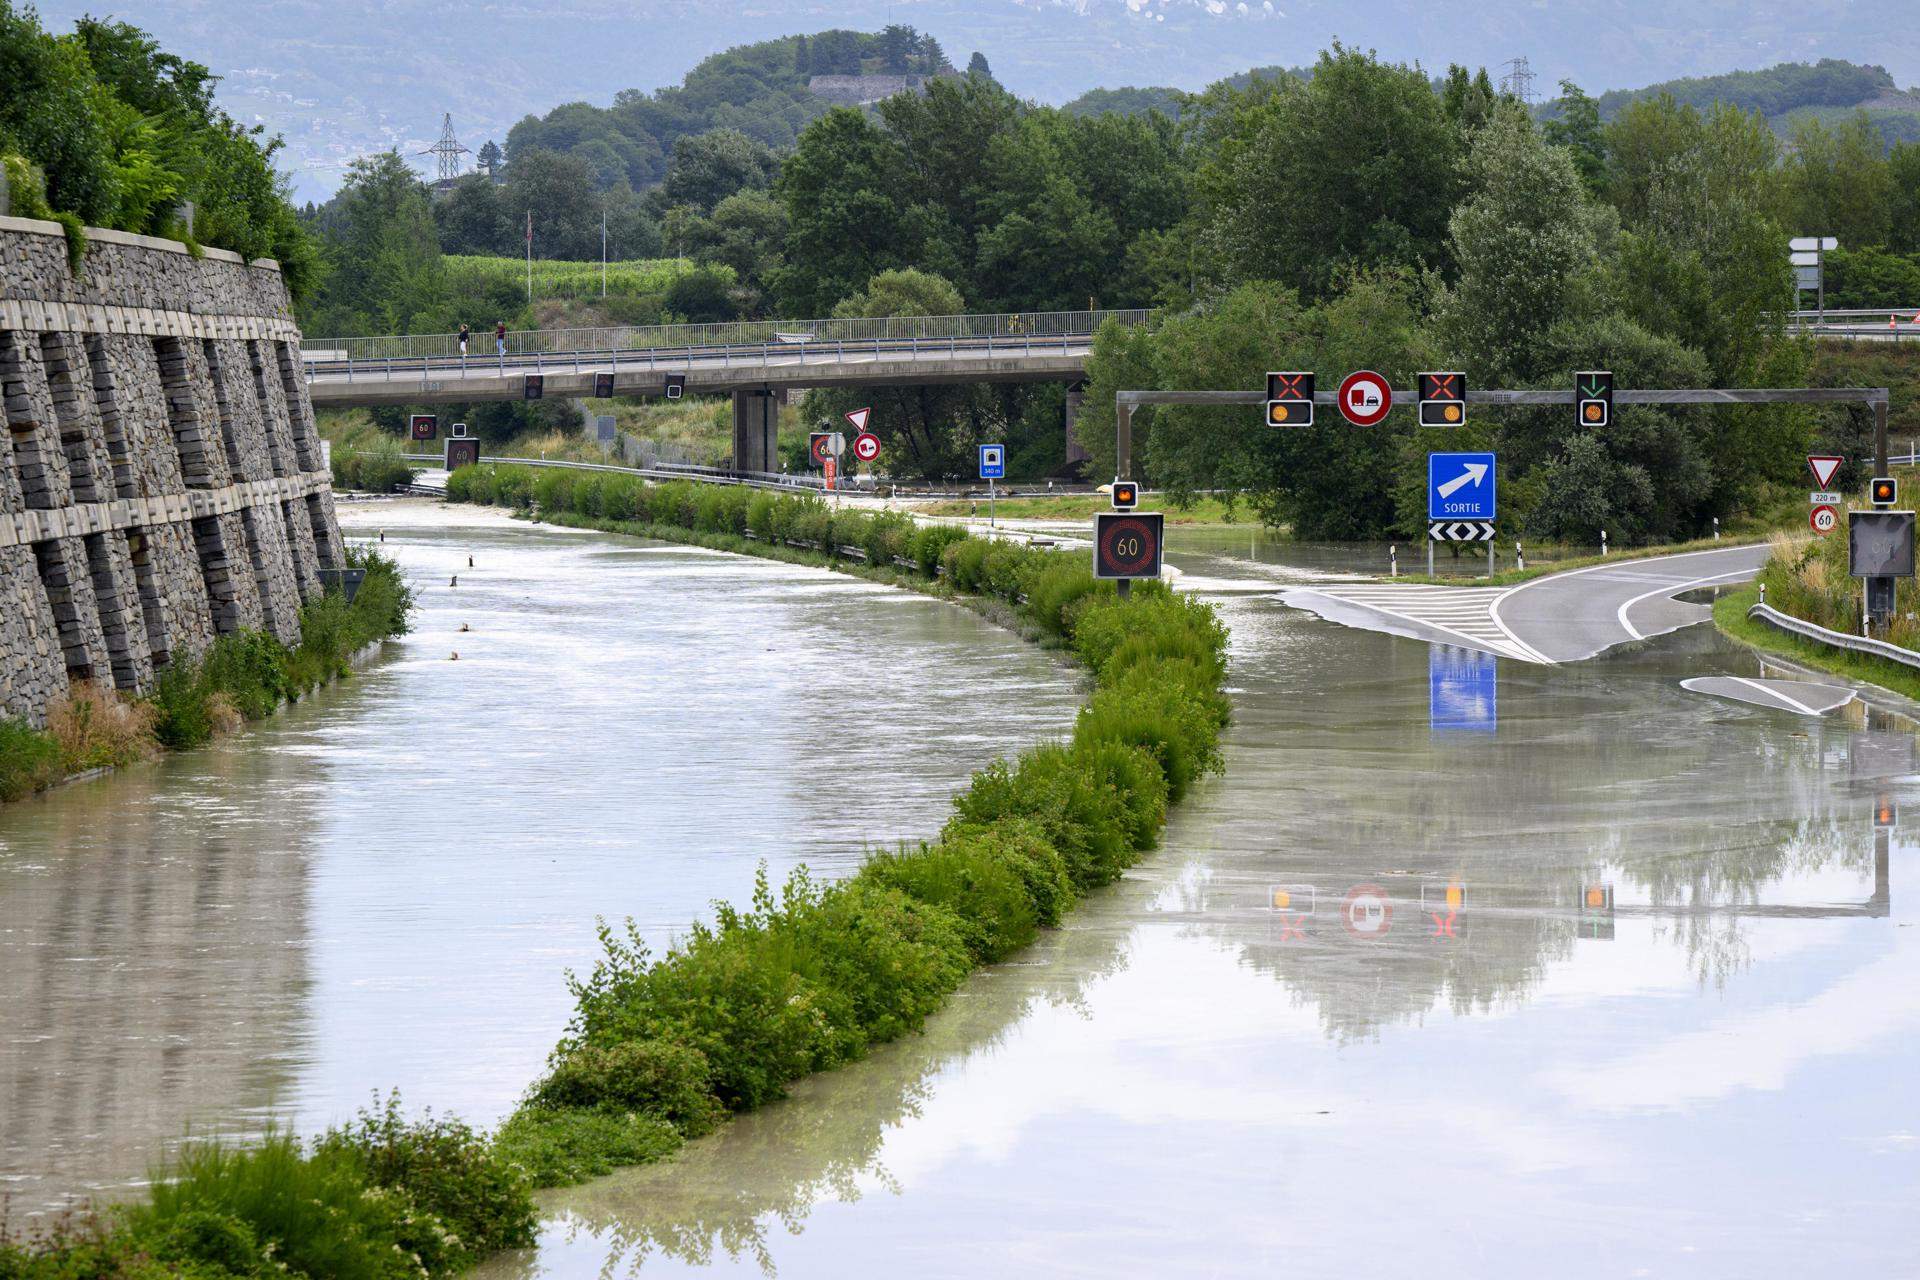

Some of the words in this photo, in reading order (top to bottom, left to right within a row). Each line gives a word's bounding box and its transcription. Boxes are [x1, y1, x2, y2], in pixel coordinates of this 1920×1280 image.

[419, 424, 429, 432] 60
[456, 450, 467, 460] 60
[1815, 494, 1828, 502] 220
[1444, 503, 1481, 513] SORTIE
[1818, 514, 1831, 526] 60
[1117, 538, 1138, 556] 60
